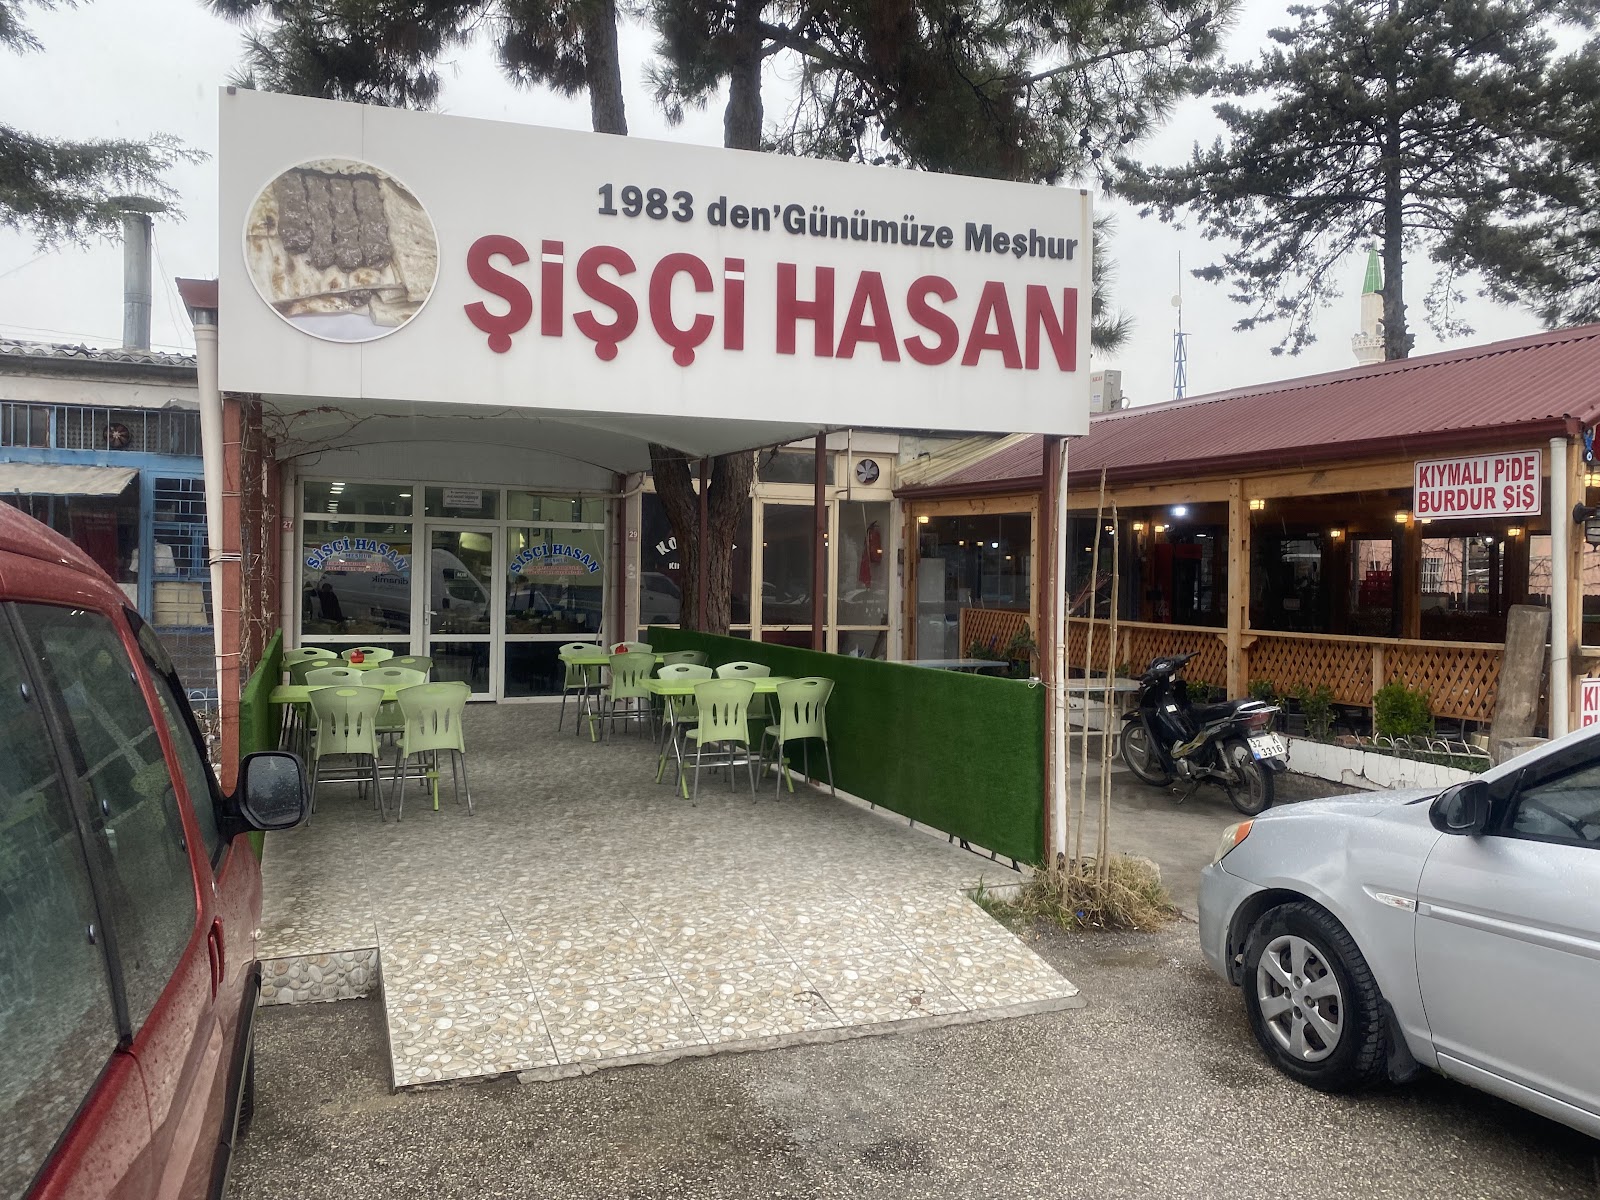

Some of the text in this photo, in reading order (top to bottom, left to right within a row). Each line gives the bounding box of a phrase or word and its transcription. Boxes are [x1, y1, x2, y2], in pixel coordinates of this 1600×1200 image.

[598, 183, 694, 223] 1983
[965, 222, 1078, 261] Meşhur
[775, 264, 1078, 372] HASAN
[1419, 460, 1488, 488] KIYMALI
[1418, 486, 1497, 513] BURDUR
[283, 520, 293, 529] 27
[354, 538, 409, 570] HASAN
[551, 544, 600, 573] HASAN
